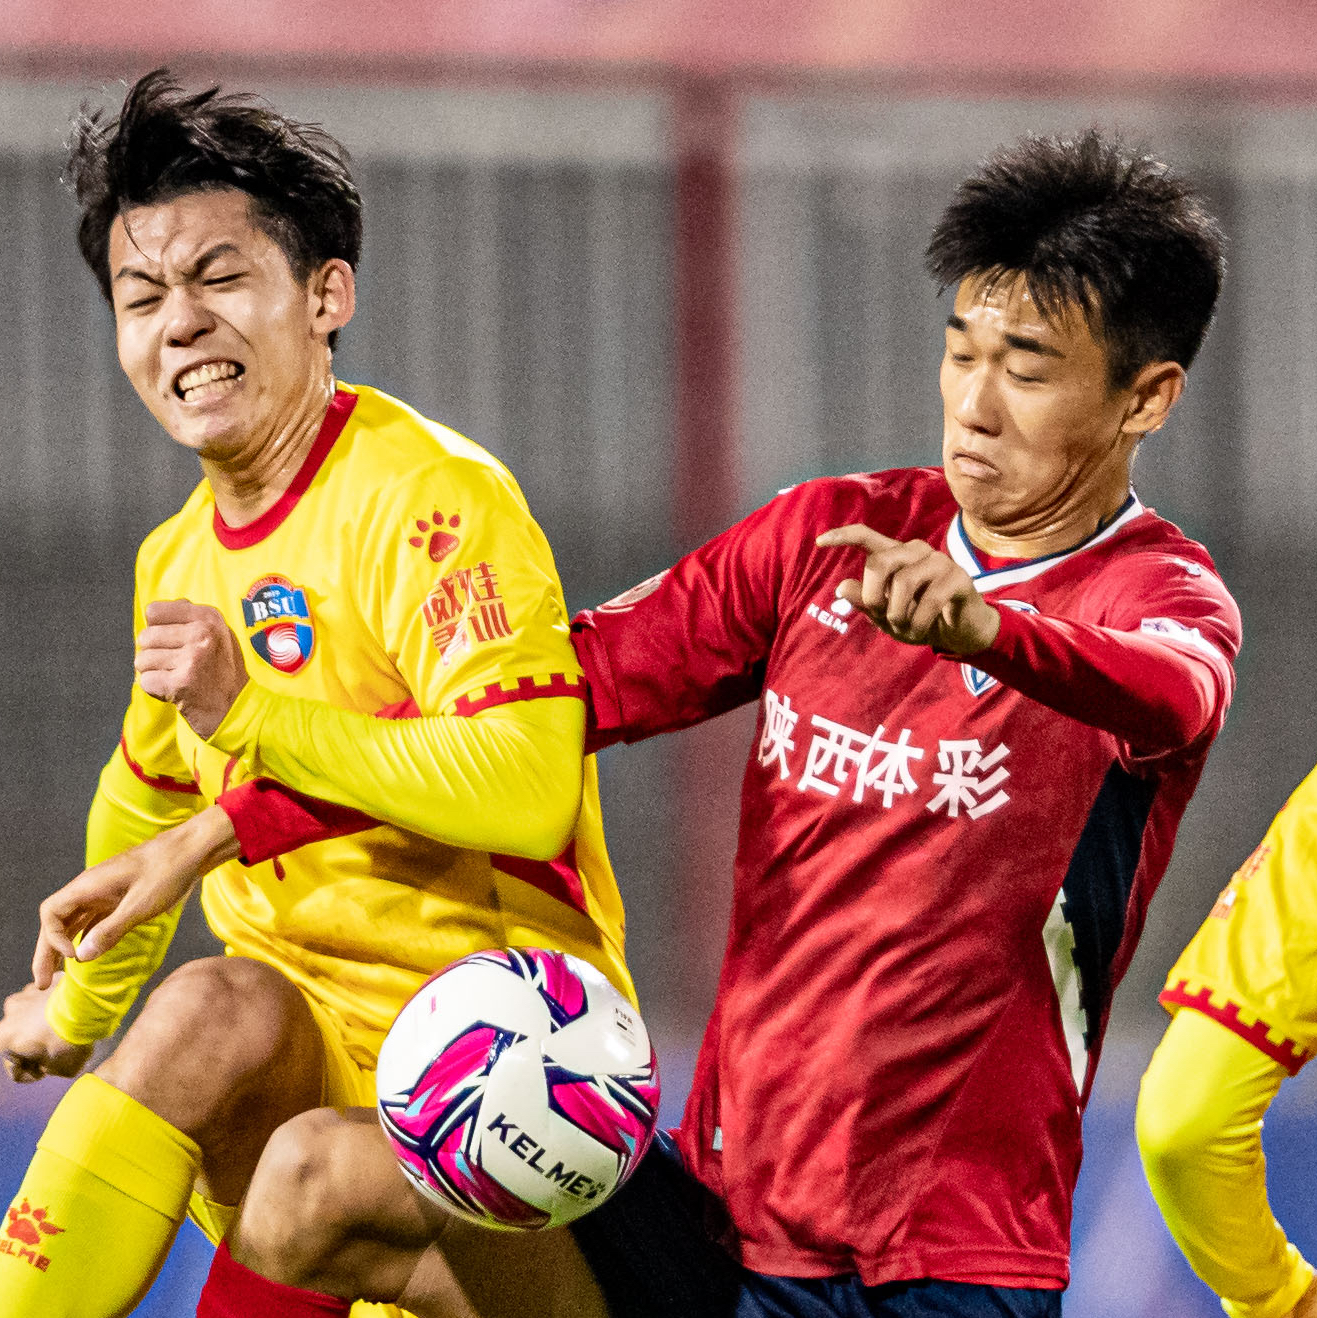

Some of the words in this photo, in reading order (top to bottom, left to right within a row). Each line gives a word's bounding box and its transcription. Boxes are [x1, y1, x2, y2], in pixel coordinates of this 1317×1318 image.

[252, 596, 296, 622] BSU
[806, 602, 849, 635] KELM
[758, 688, 1011, 821] 陕西体彩
[486, 1112, 595, 1198] KELME
